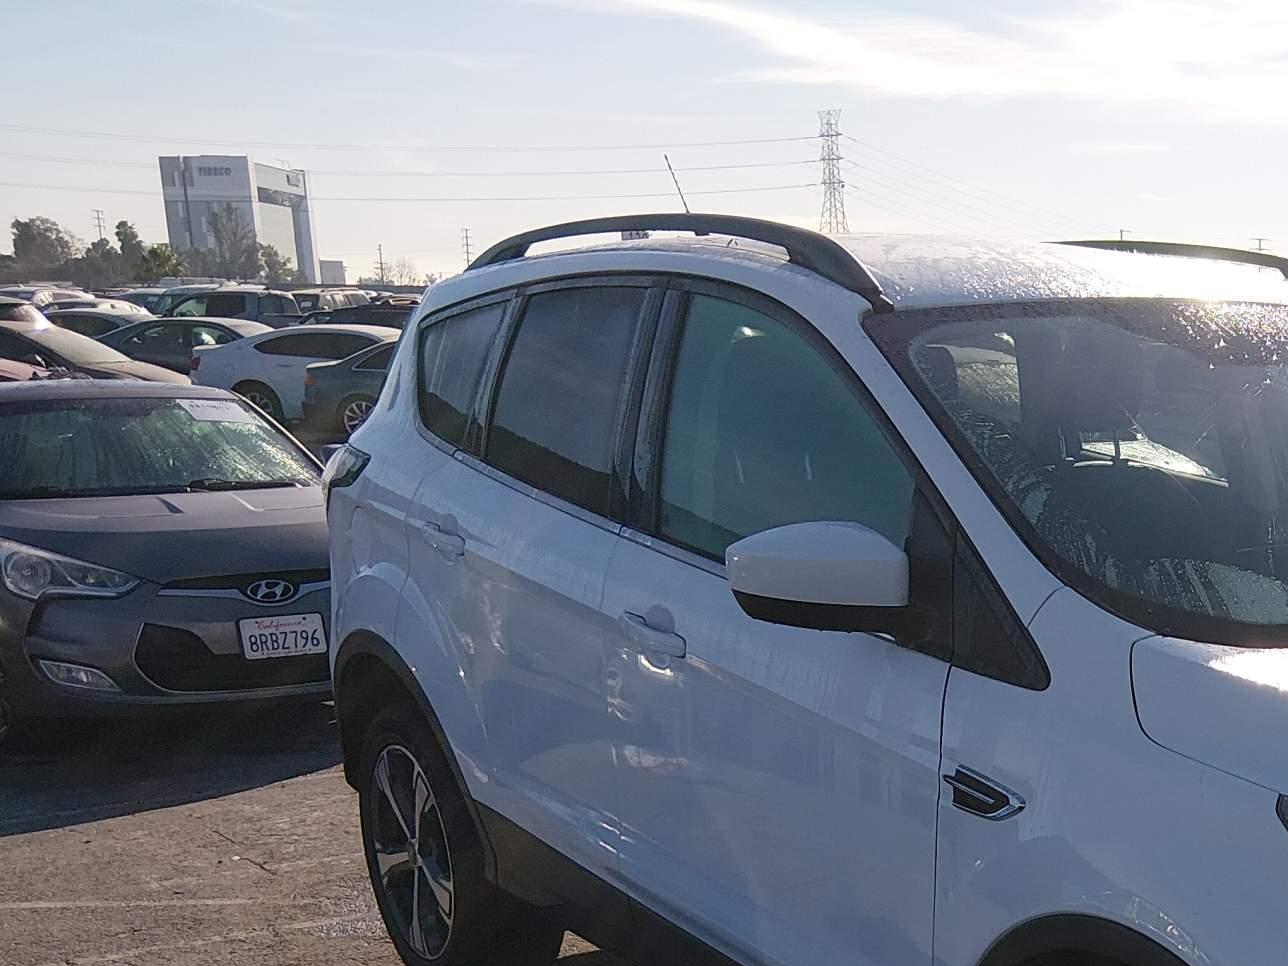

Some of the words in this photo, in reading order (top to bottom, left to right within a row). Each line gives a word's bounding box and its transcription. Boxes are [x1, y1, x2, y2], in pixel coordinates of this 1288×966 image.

[197, 166, 232, 177] TIRECO
[256, 620, 305, 631] California
[248, 628, 321, 653] 8RBZ796
